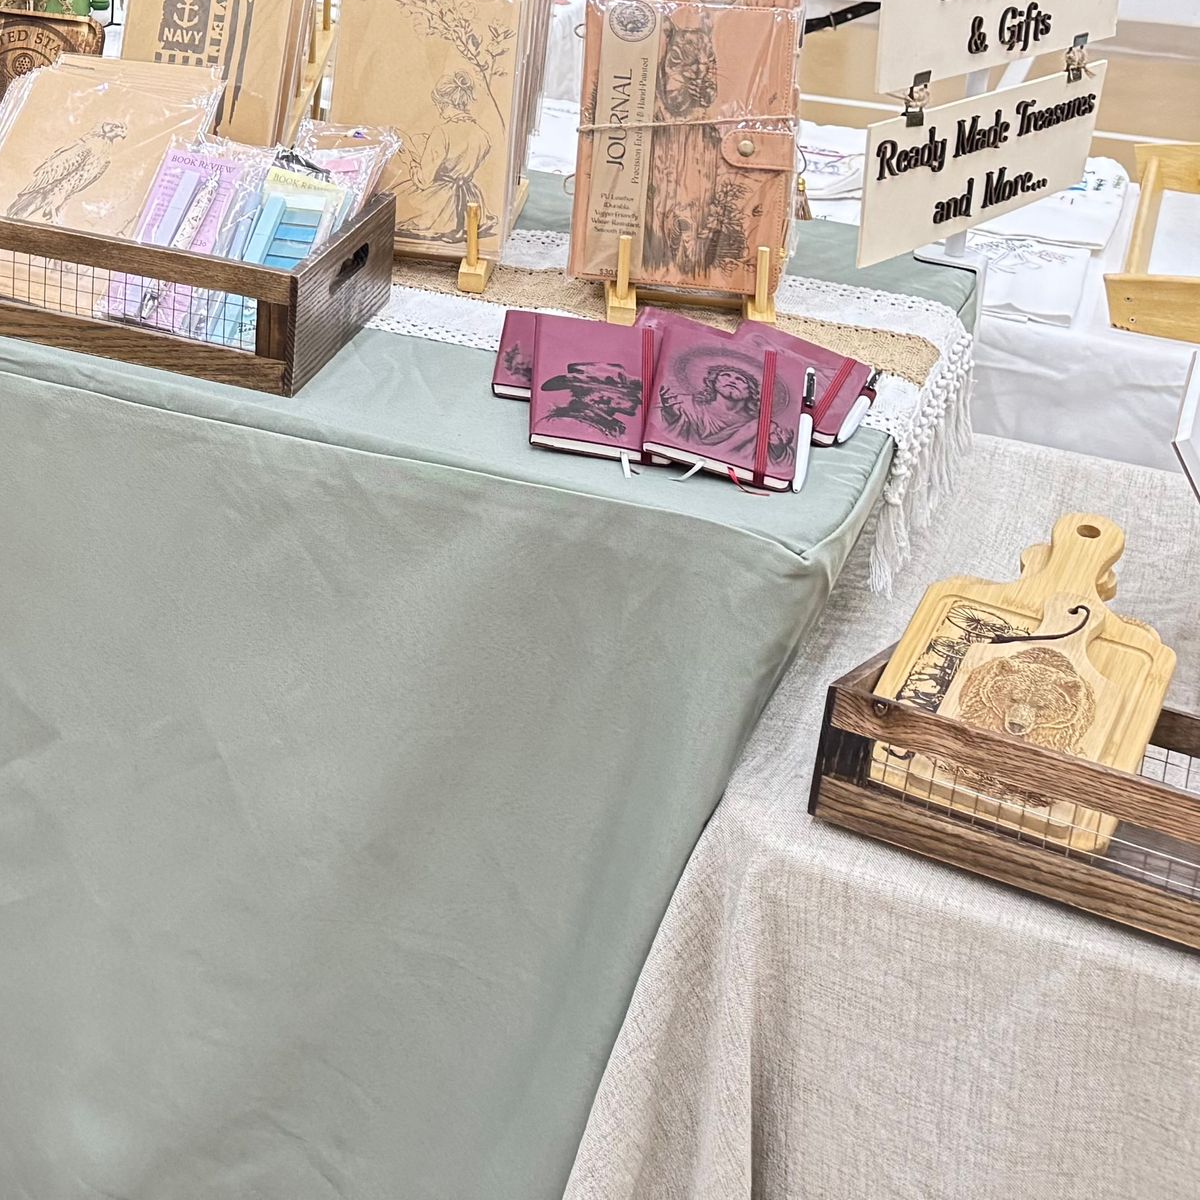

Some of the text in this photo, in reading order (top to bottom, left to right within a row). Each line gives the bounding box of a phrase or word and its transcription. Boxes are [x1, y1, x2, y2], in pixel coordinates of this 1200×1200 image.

[34, 31, 63, 57] STA
[162, 26, 204, 45] NAVY
[968, 2, 1052, 54] & Gifts
[606, 68, 633, 171] JOURNAL
[876, 92, 1096, 181] Ready Made Treasures
[171, 154, 237, 174] BOOK REVIEW
[273, 173, 300, 188] BOOK
[933, 166, 1048, 224] and More...
